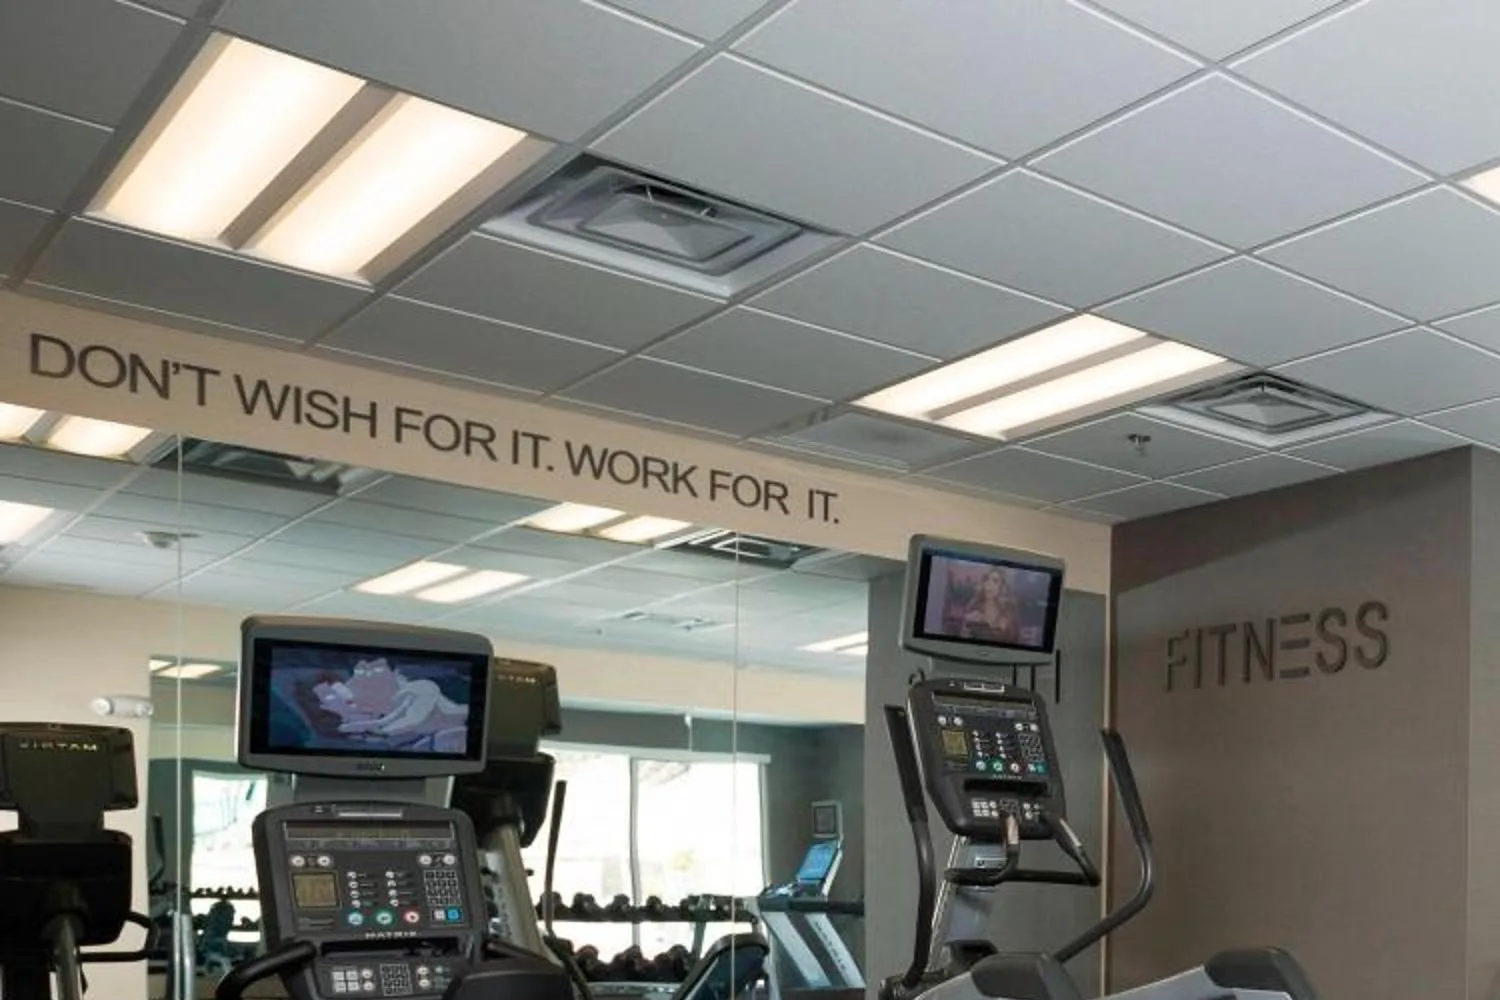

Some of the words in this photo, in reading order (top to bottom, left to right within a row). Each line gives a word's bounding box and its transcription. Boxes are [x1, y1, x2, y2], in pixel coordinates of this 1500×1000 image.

[29, 333, 221, 407] DON'T
[234, 373, 377, 438] WISH
[393, 406, 498, 462] FOR
[512, 429, 554, 472] IT.
[565, 440, 698, 499] WORK
[709, 469, 790, 515] FOR
[807, 489, 839, 524] IT.
[1165, 600, 1389, 692] FITNESS
